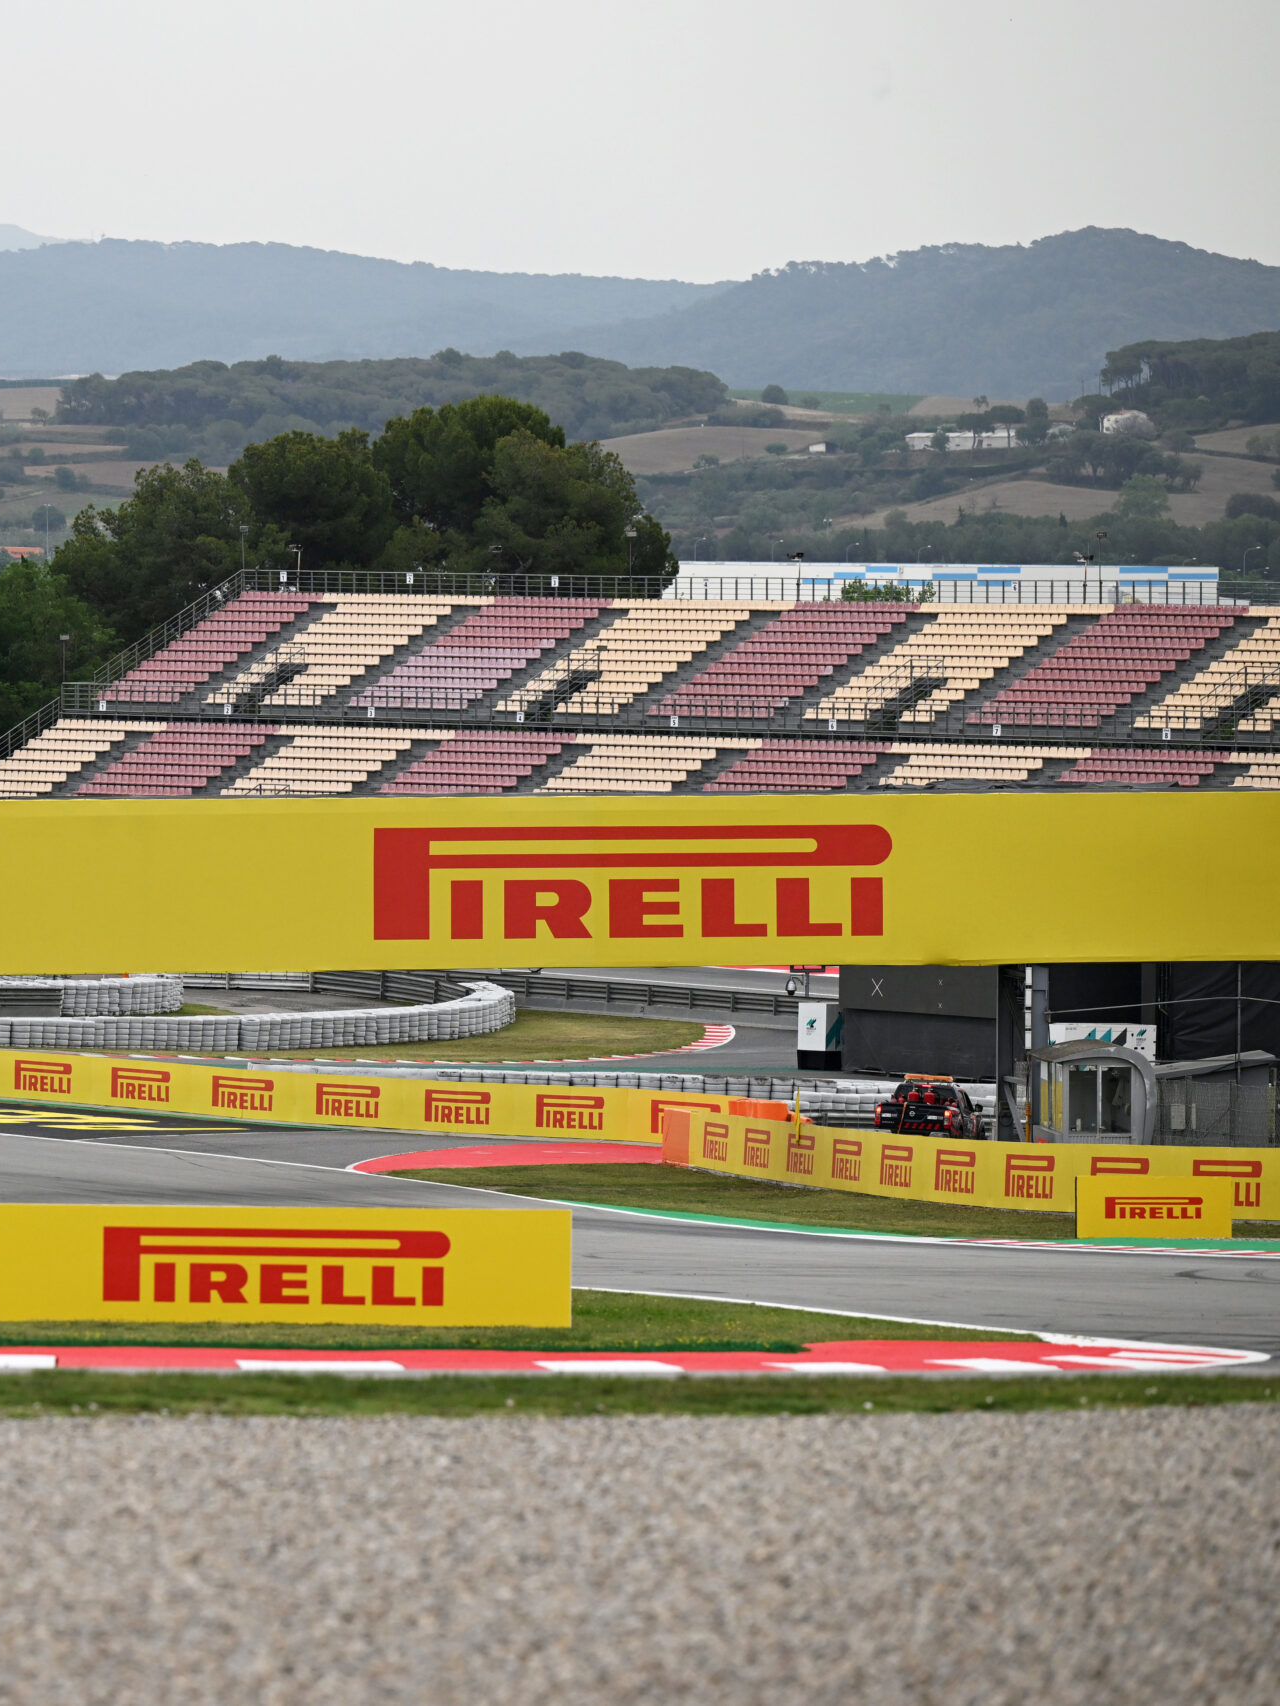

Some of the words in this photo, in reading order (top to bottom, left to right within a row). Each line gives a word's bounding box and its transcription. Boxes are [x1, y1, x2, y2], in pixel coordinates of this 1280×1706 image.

[373, 824, 893, 940] PIRELLI
[14, 1060, 72, 1094] PIRELLI
[111, 1067, 171, 1102] PIRELLI
[211, 1075, 274, 1112] PIRELLI
[316, 1082, 381, 1119] PIRELLI
[424, 1089, 491, 1125] PIRELLI
[536, 1094, 605, 1130] PIRELLI
[702, 1122, 728, 1161] PIRELLI
[744, 1128, 771, 1168] PIRELLI
[787, 1133, 815, 1174] PIRELLI
[832, 1139, 862, 1181] PIRELLI
[880, 1144, 914, 1188] PIRELLI
[934, 1149, 976, 1194] PIRELLI
[1004, 1154, 1055, 1199] PIRELLI
[1104, 1196, 1204, 1220] PIRELLI
[102, 1226, 451, 1307] PIRELLI
